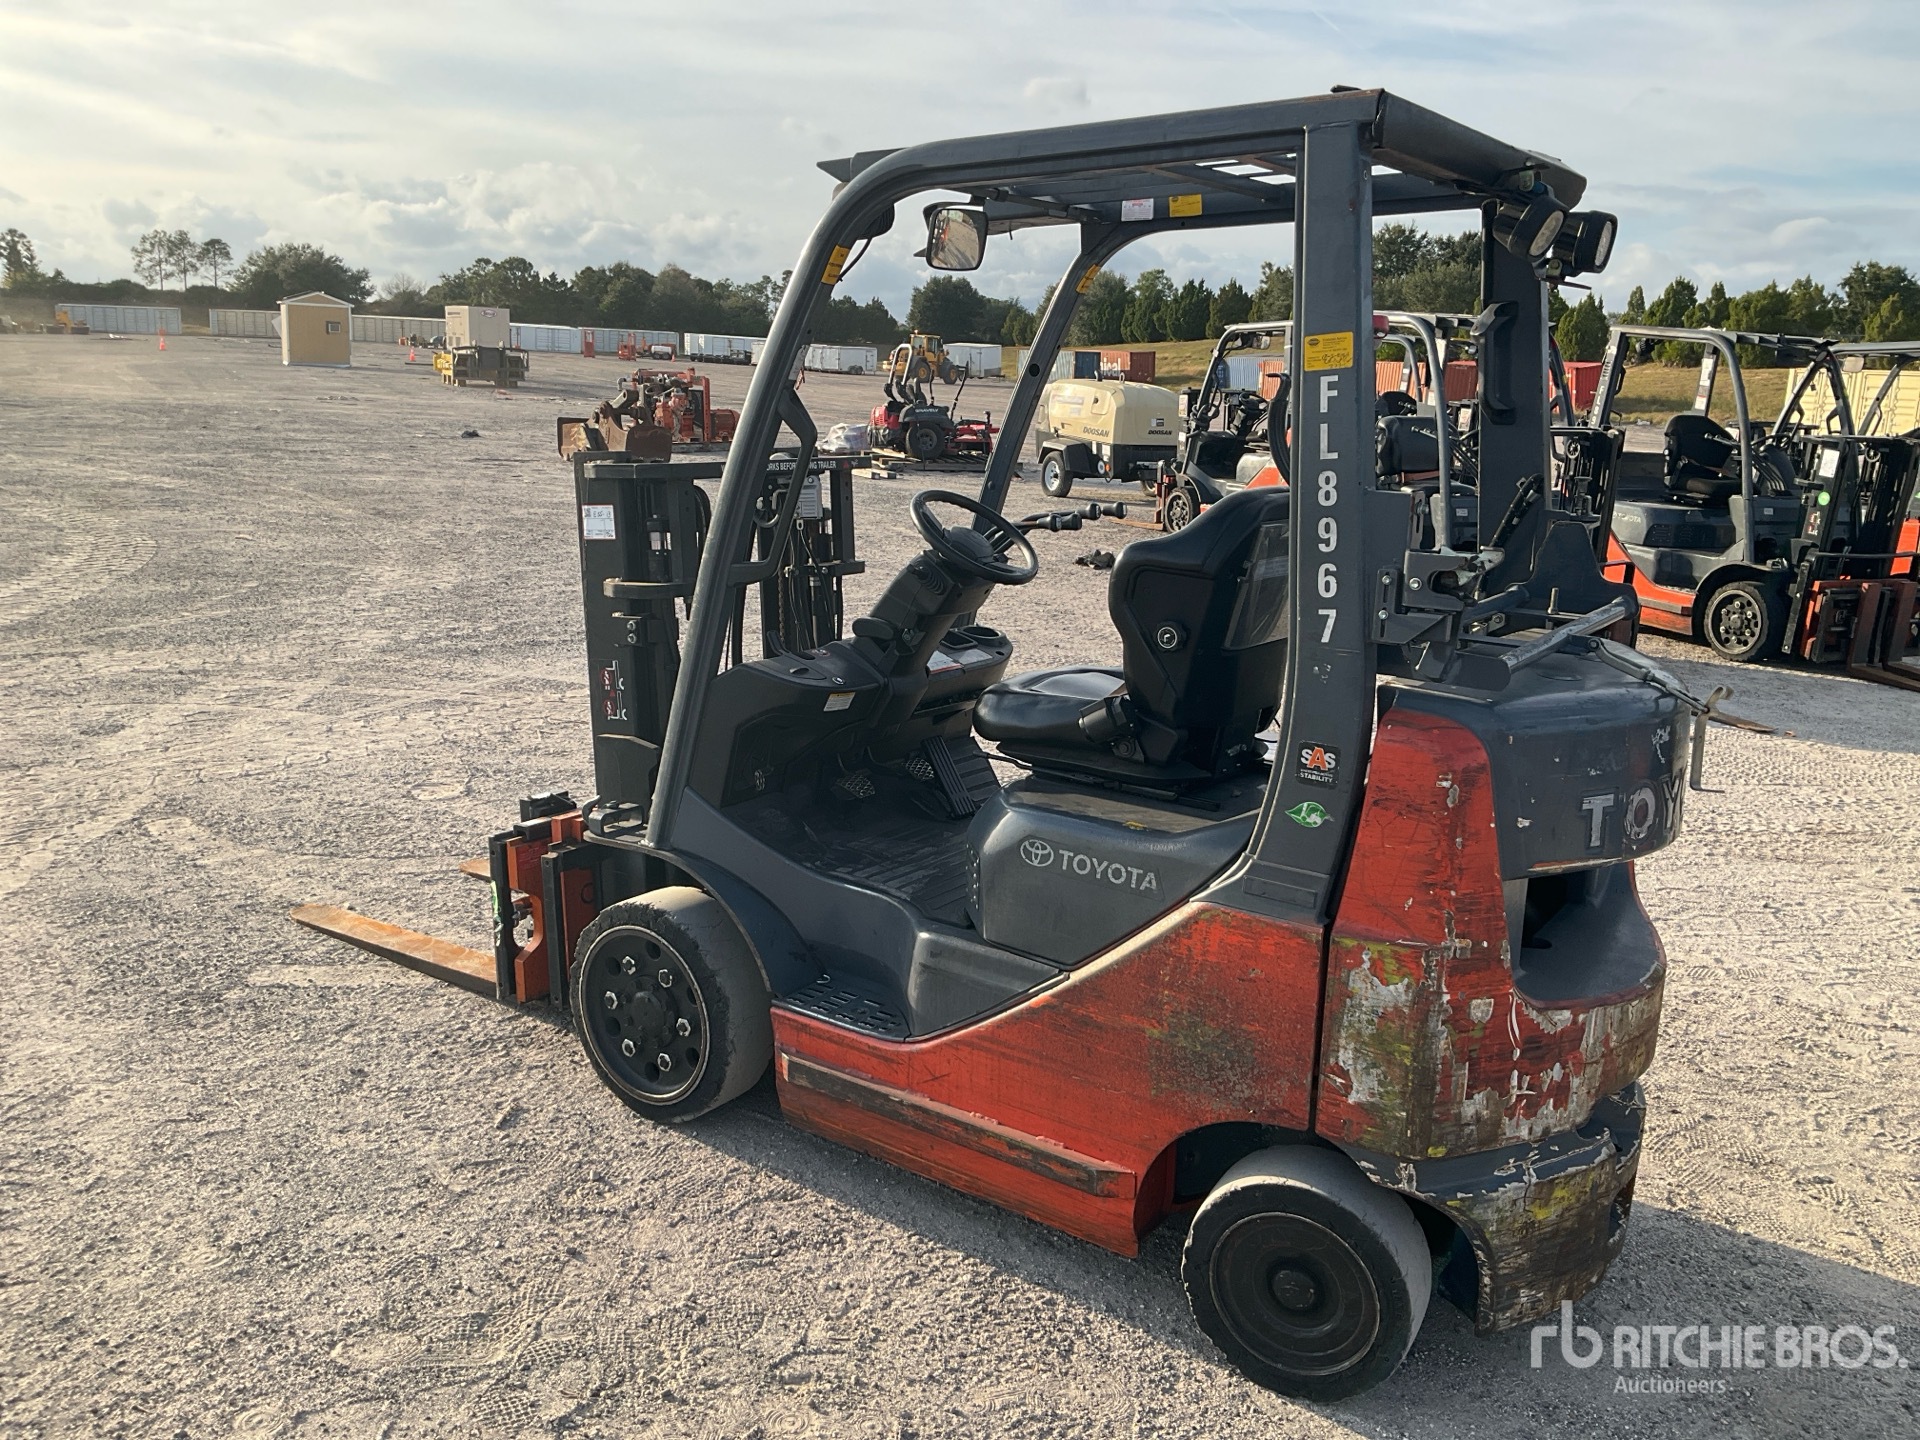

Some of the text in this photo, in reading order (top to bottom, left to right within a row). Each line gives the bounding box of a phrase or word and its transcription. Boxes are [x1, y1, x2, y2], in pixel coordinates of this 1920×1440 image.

[1082, 426, 1110, 438] DOOSAN
[780, 461, 797, 471] BEFOR
[818, 460, 837, 469] TRAILER
[1317, 374, 1339, 643] FL8967
[1300, 746, 1336, 771] SAS
[1300, 772, 1333, 783] STABILITY
[1581, 769, 1684, 847] TOY
[1059, 849, 1157, 891] TOYOTA
